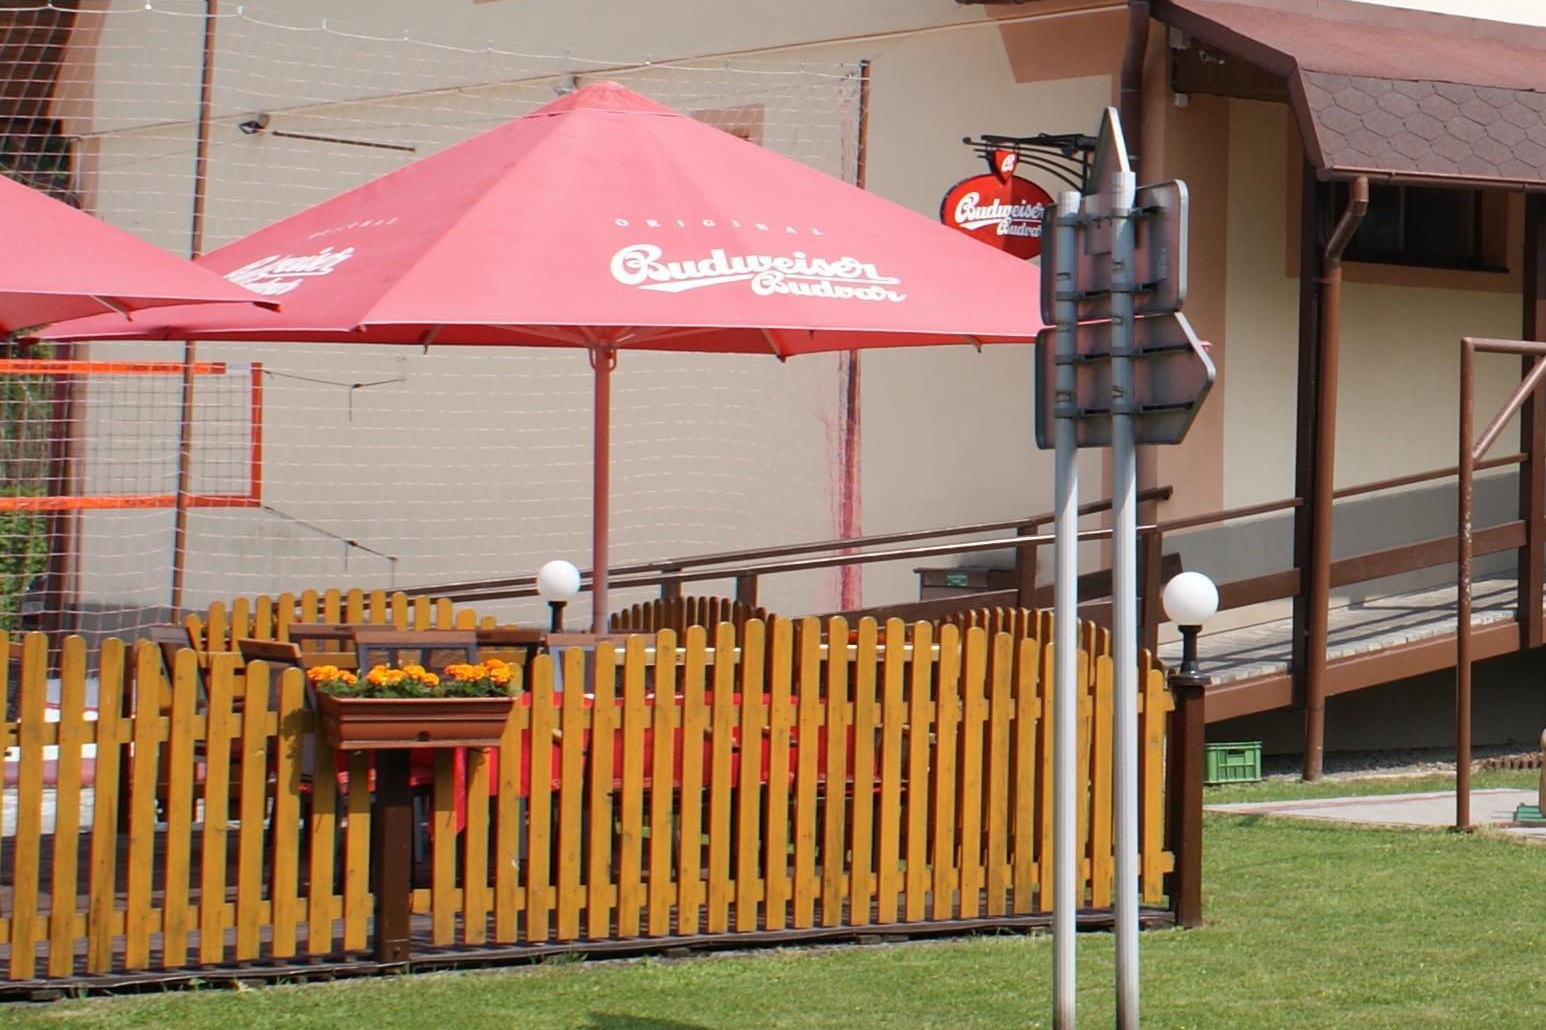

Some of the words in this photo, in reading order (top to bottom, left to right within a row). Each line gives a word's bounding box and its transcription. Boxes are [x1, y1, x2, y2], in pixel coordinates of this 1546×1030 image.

[614, 218, 824, 236] ORIGINAL
[996, 217, 1042, 237] Budva
[610, 243, 901, 286] Budweiser
[751, 270, 907, 303] Budvar
